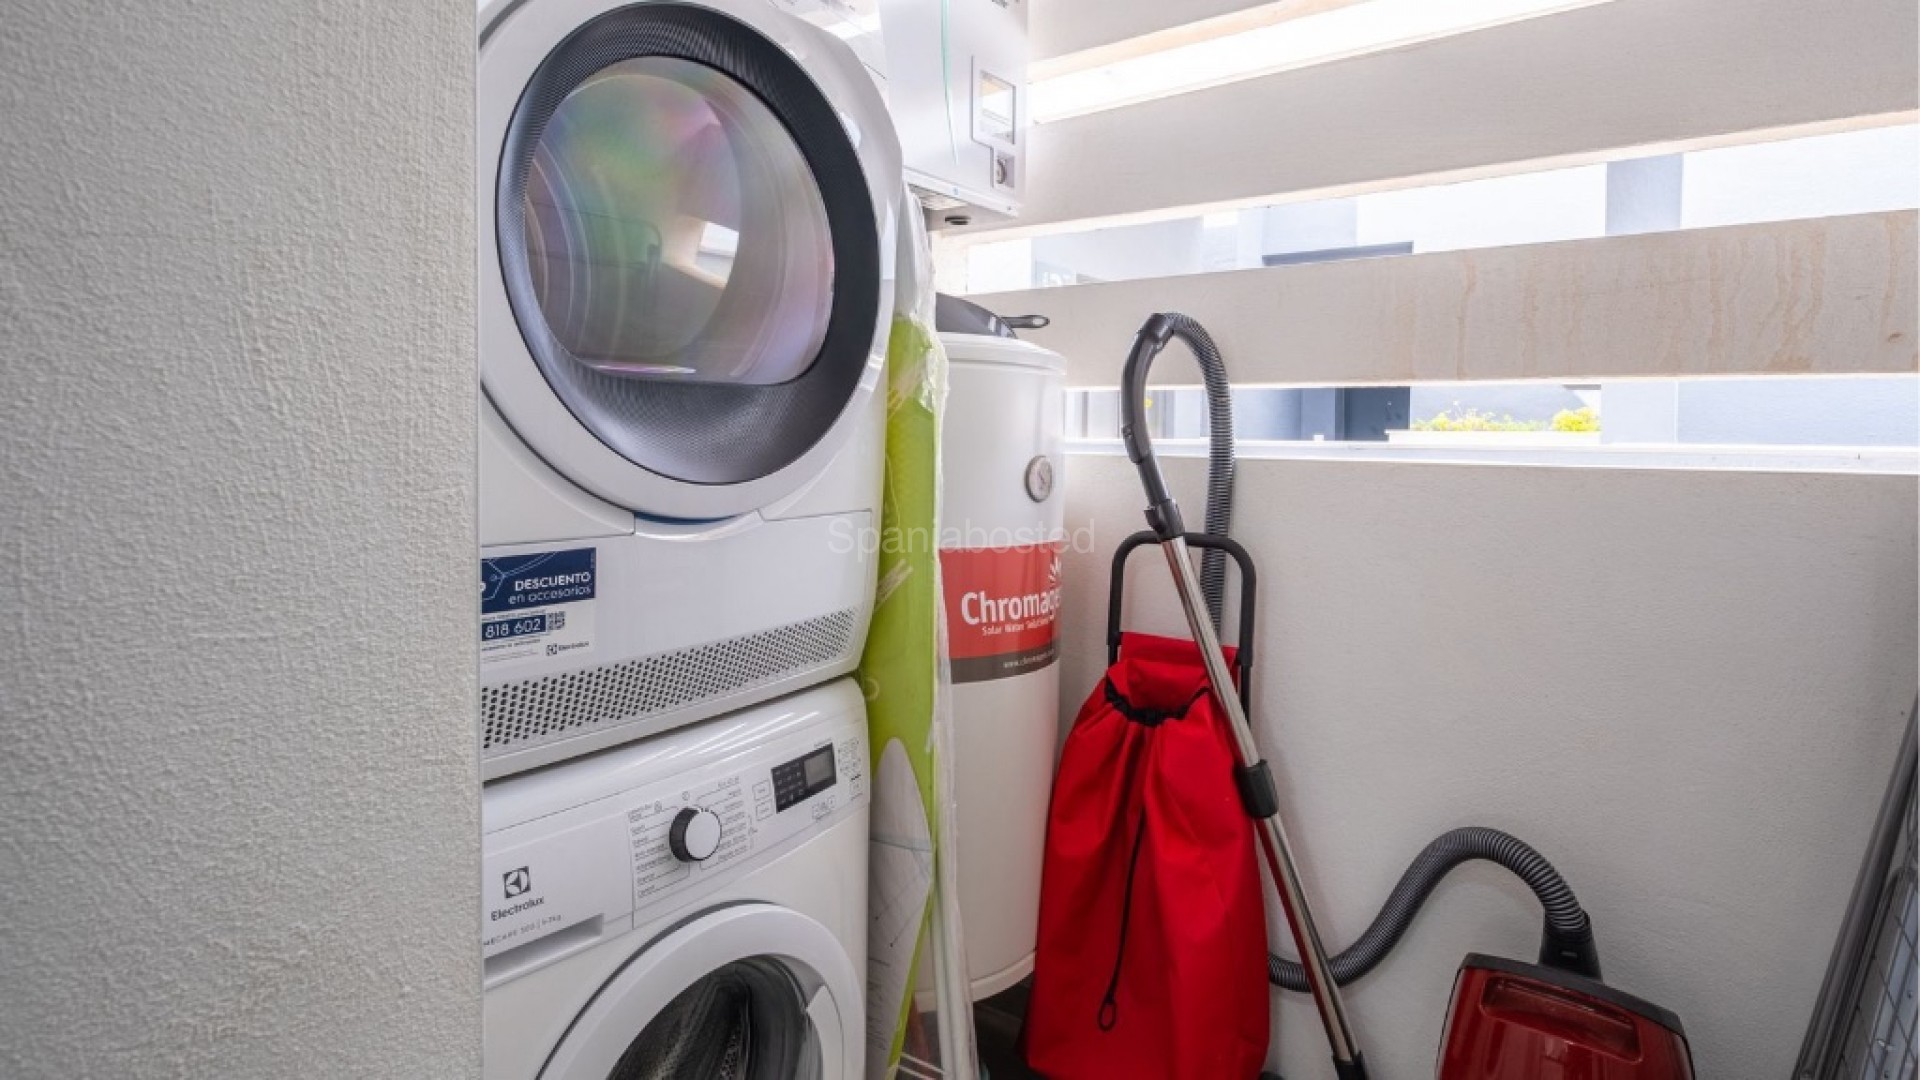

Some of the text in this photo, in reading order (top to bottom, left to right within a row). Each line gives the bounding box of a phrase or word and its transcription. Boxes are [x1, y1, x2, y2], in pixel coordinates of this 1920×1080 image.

[514, 571, 592, 592] DESCUENTO
[508, 584, 592, 605] en accesorios
[485, 618, 541, 639] 818 602
[981, 625, 1002, 637] Solar
[491, 897, 544, 921] Electrolux
